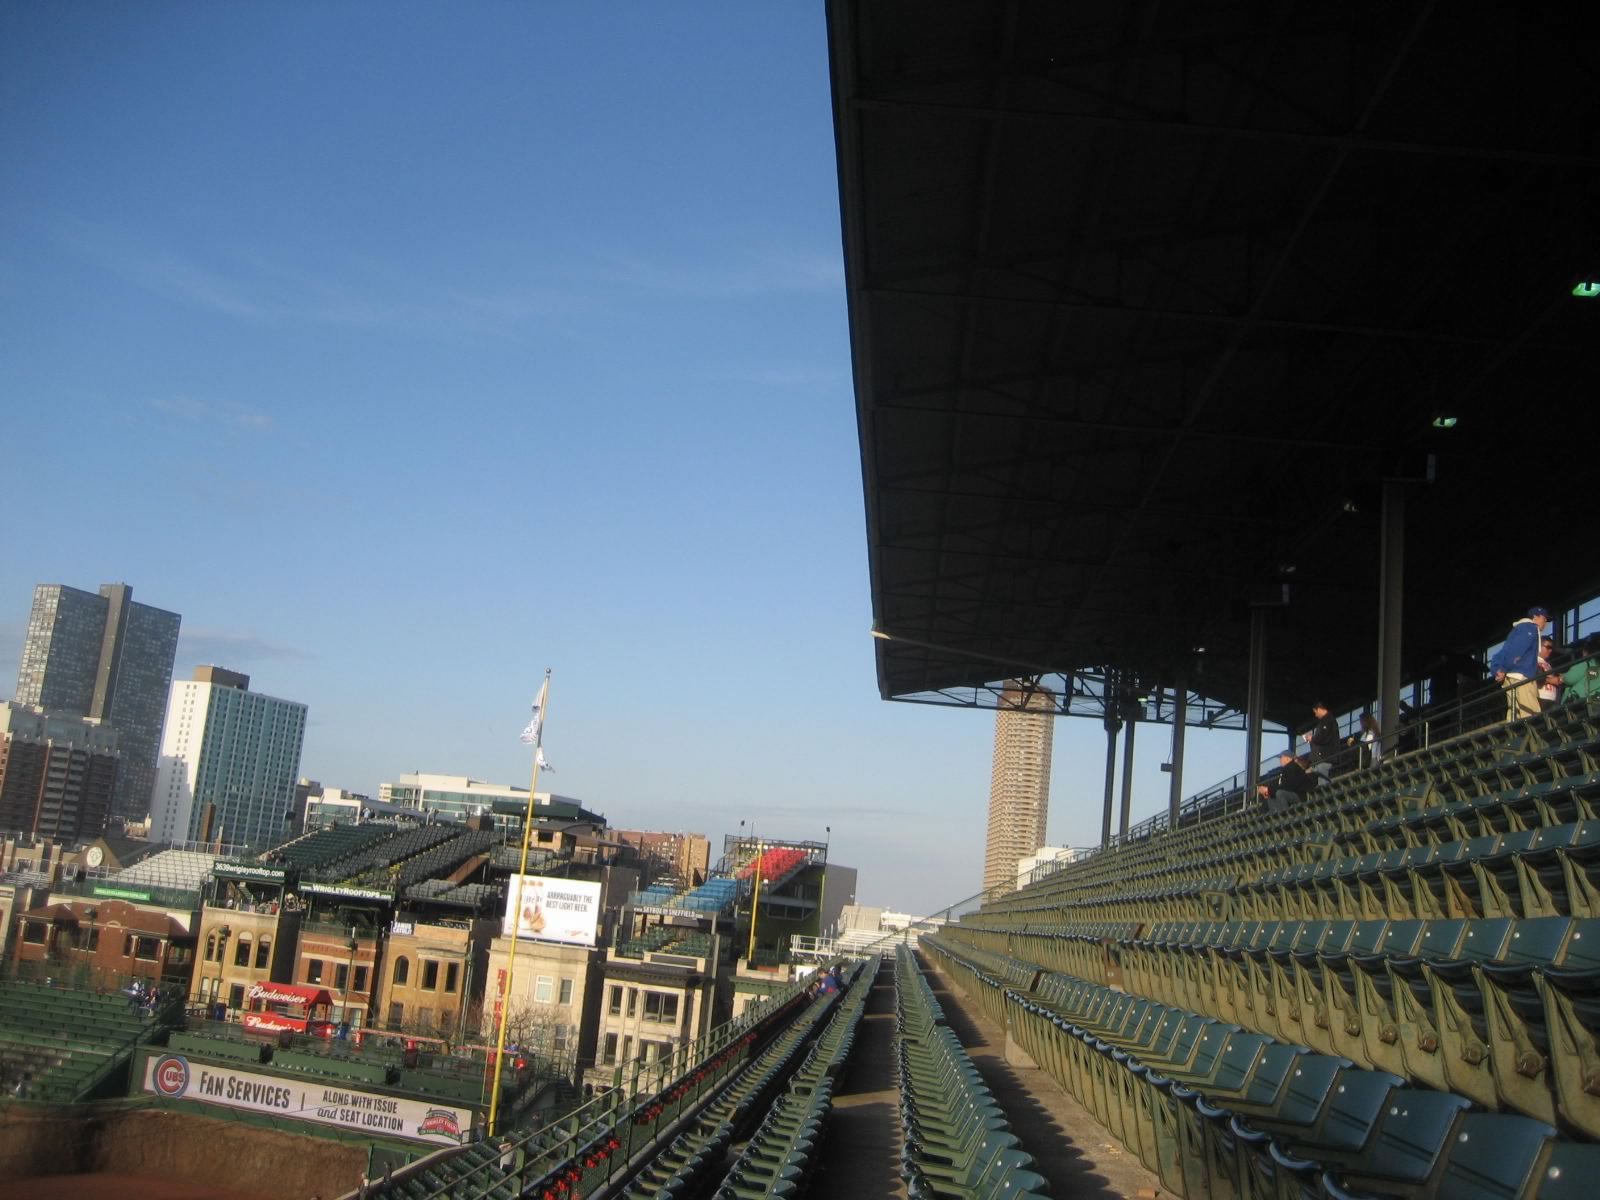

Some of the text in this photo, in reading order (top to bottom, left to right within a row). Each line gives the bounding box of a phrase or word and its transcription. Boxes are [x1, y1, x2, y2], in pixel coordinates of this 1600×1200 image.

[215, 862, 285, 878] 3639wrigleyrooftop.com
[248, 985, 307, 1004] Budweiser
[322, 1089, 398, 1114] ALONG WITH ISSUE
[316, 1107, 404, 1131] and SEAT LOCATION
